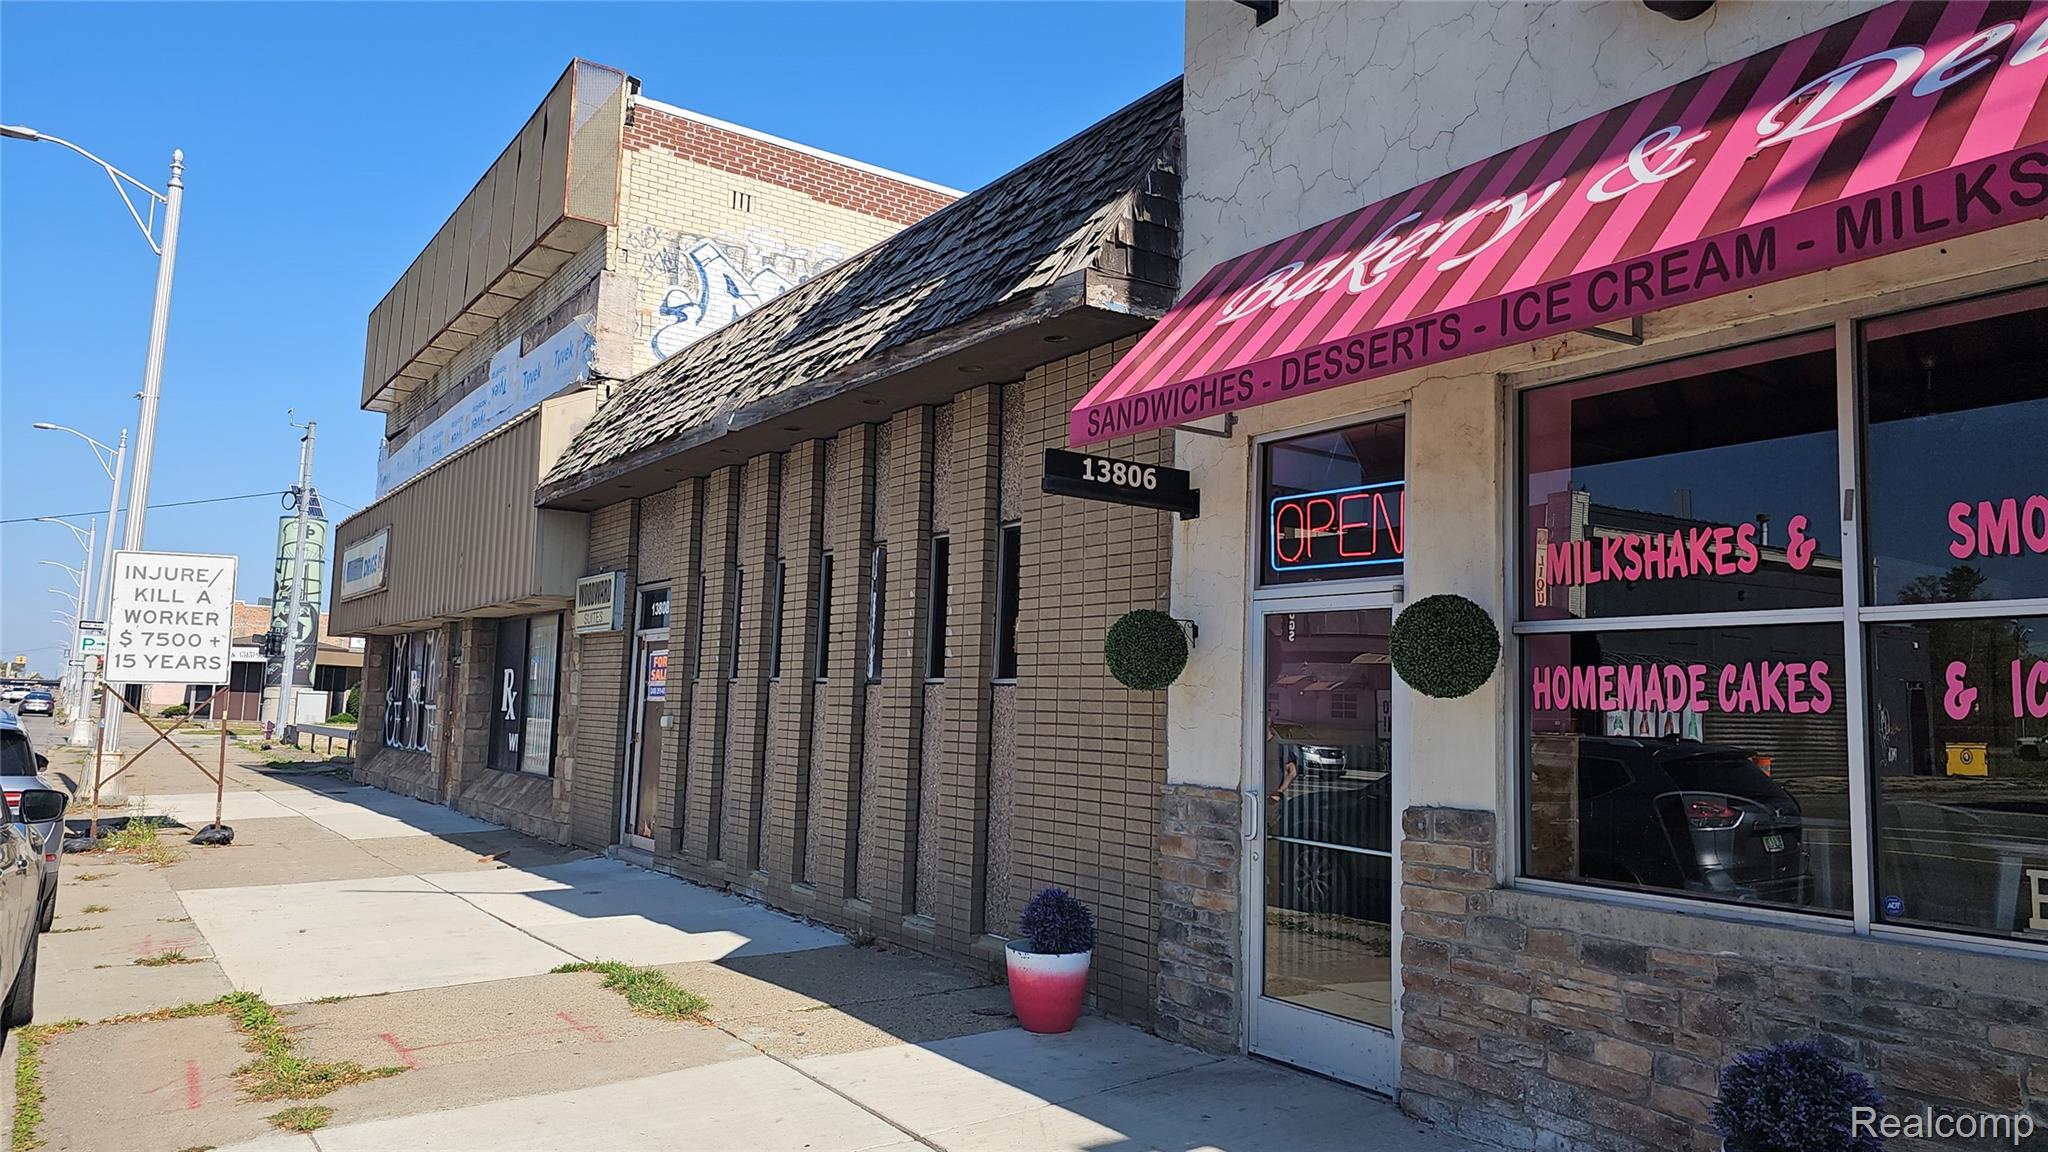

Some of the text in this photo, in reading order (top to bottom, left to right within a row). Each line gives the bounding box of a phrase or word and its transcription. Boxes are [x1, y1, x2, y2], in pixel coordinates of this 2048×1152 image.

[1215, 178, 1566, 326] Bakery
[1586, 124, 1711, 203] &
[1087, 369, 1255, 437] SANDWICHES
[1281, 312, 1461, 392] DESSERTS
[1500, 283, 1572, 338] ICE
[1586, 226, 1777, 314] CREAM
[1083, 458, 1157, 490] 13806
[1277, 492, 1404, 562] OPEN
[1547, 515, 1817, 587] MILKSHAKES &
[125, 565, 224, 588] INJURE/
[134, 588, 211, 604] KILL A
[124, 609, 219, 626] WORKER
[584, 610, 603, 624] SUITES
[119, 629, 220, 648] $ 7500 +
[114, 653, 221, 670] 15 YEARS
[653, 656, 667, 668] FOR
[1532, 660, 1832, 714] HOMEMADE CAKES
[1944, 661, 1977, 720] &
[1887, 902, 1901, 910] ADT
